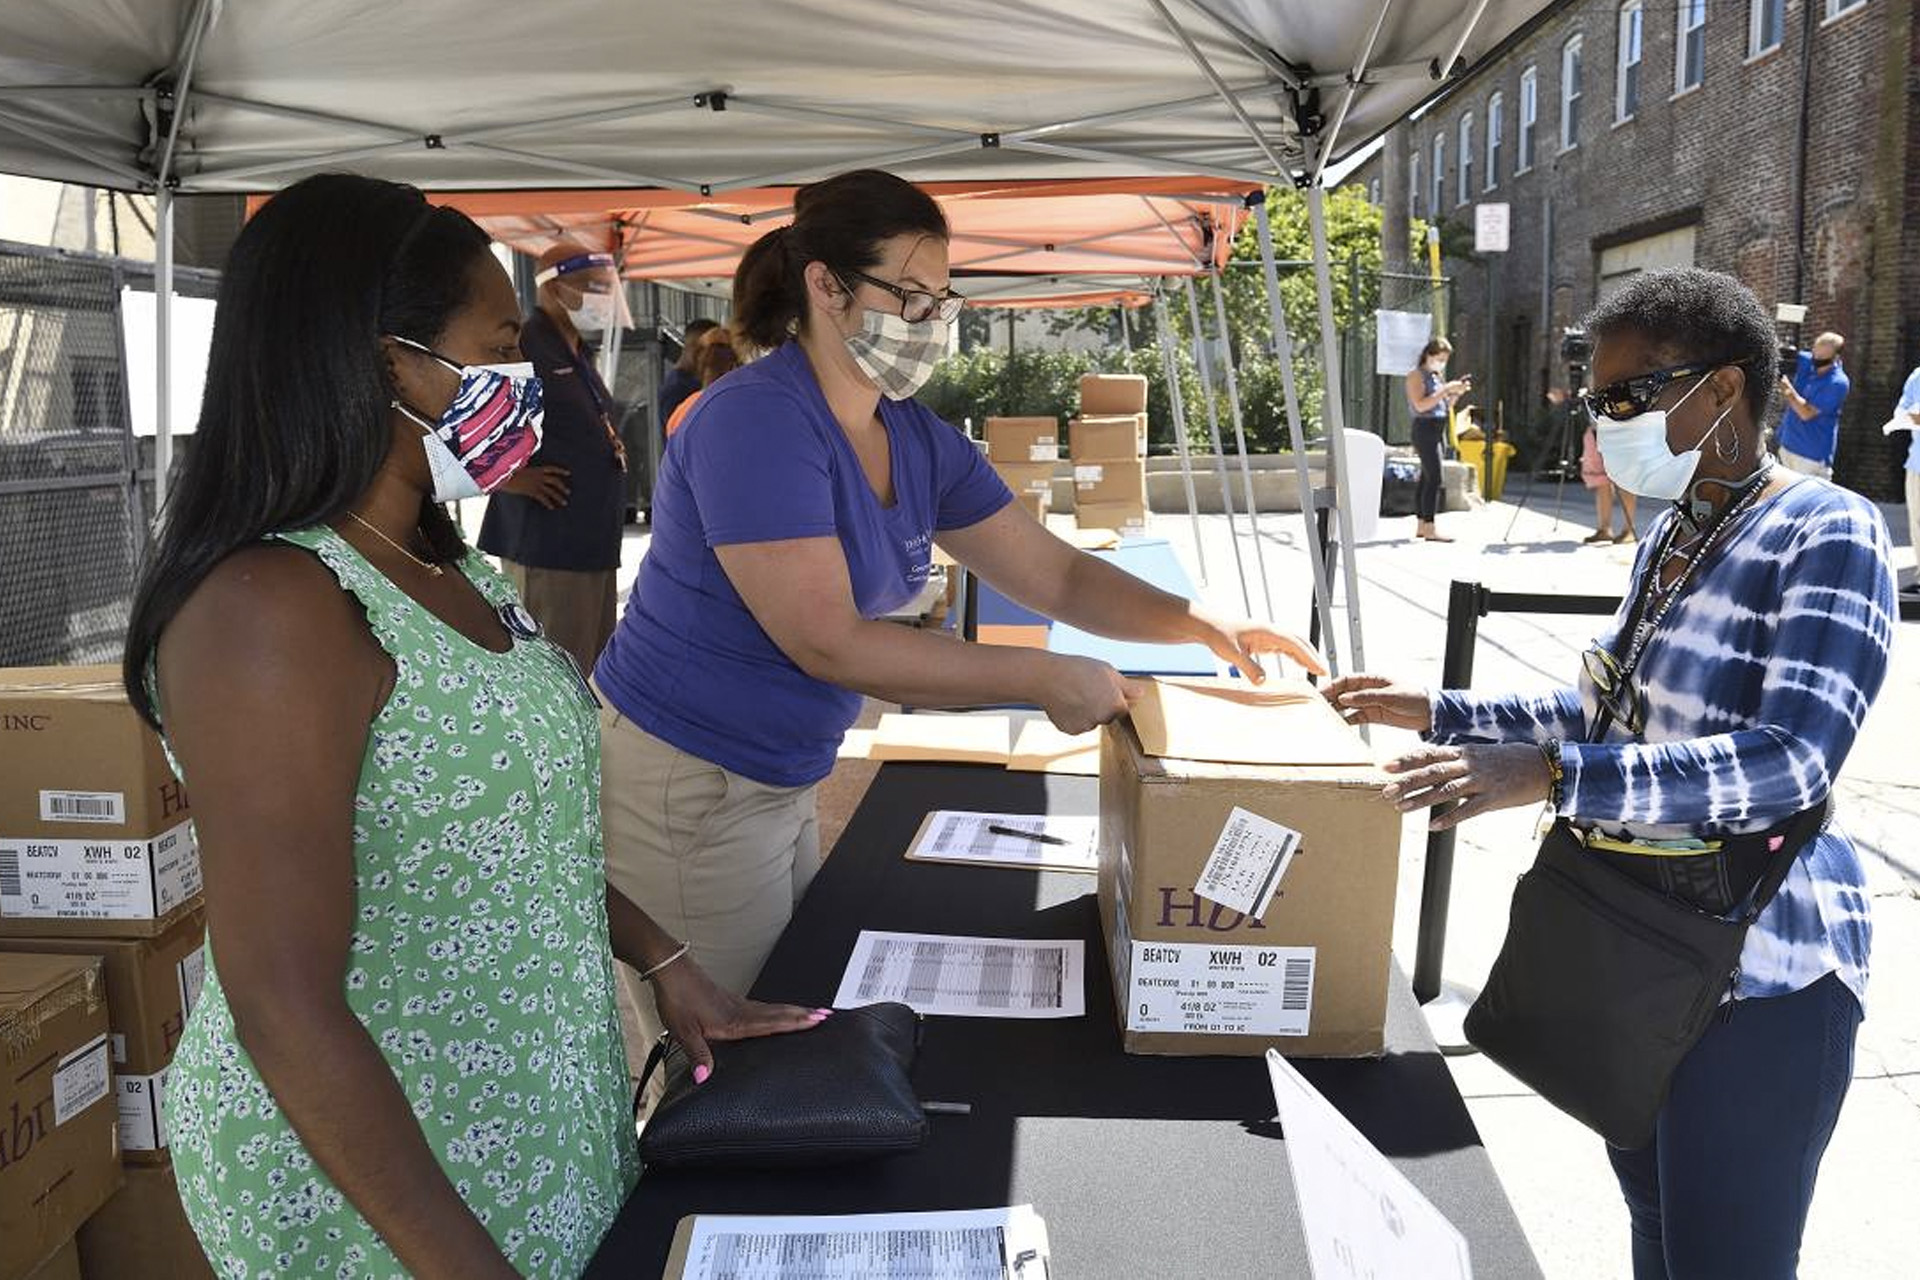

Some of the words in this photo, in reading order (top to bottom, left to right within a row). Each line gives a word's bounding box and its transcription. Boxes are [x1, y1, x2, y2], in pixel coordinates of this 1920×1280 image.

[83, 846, 112, 859] XWH
[124, 846, 142, 859] 02
[1143, 948, 1181, 964] BEATCV
[1208, 951, 1242, 965] XWH
[1258, 952, 1278, 966] 02
[126, 1081, 142, 1093] 02
